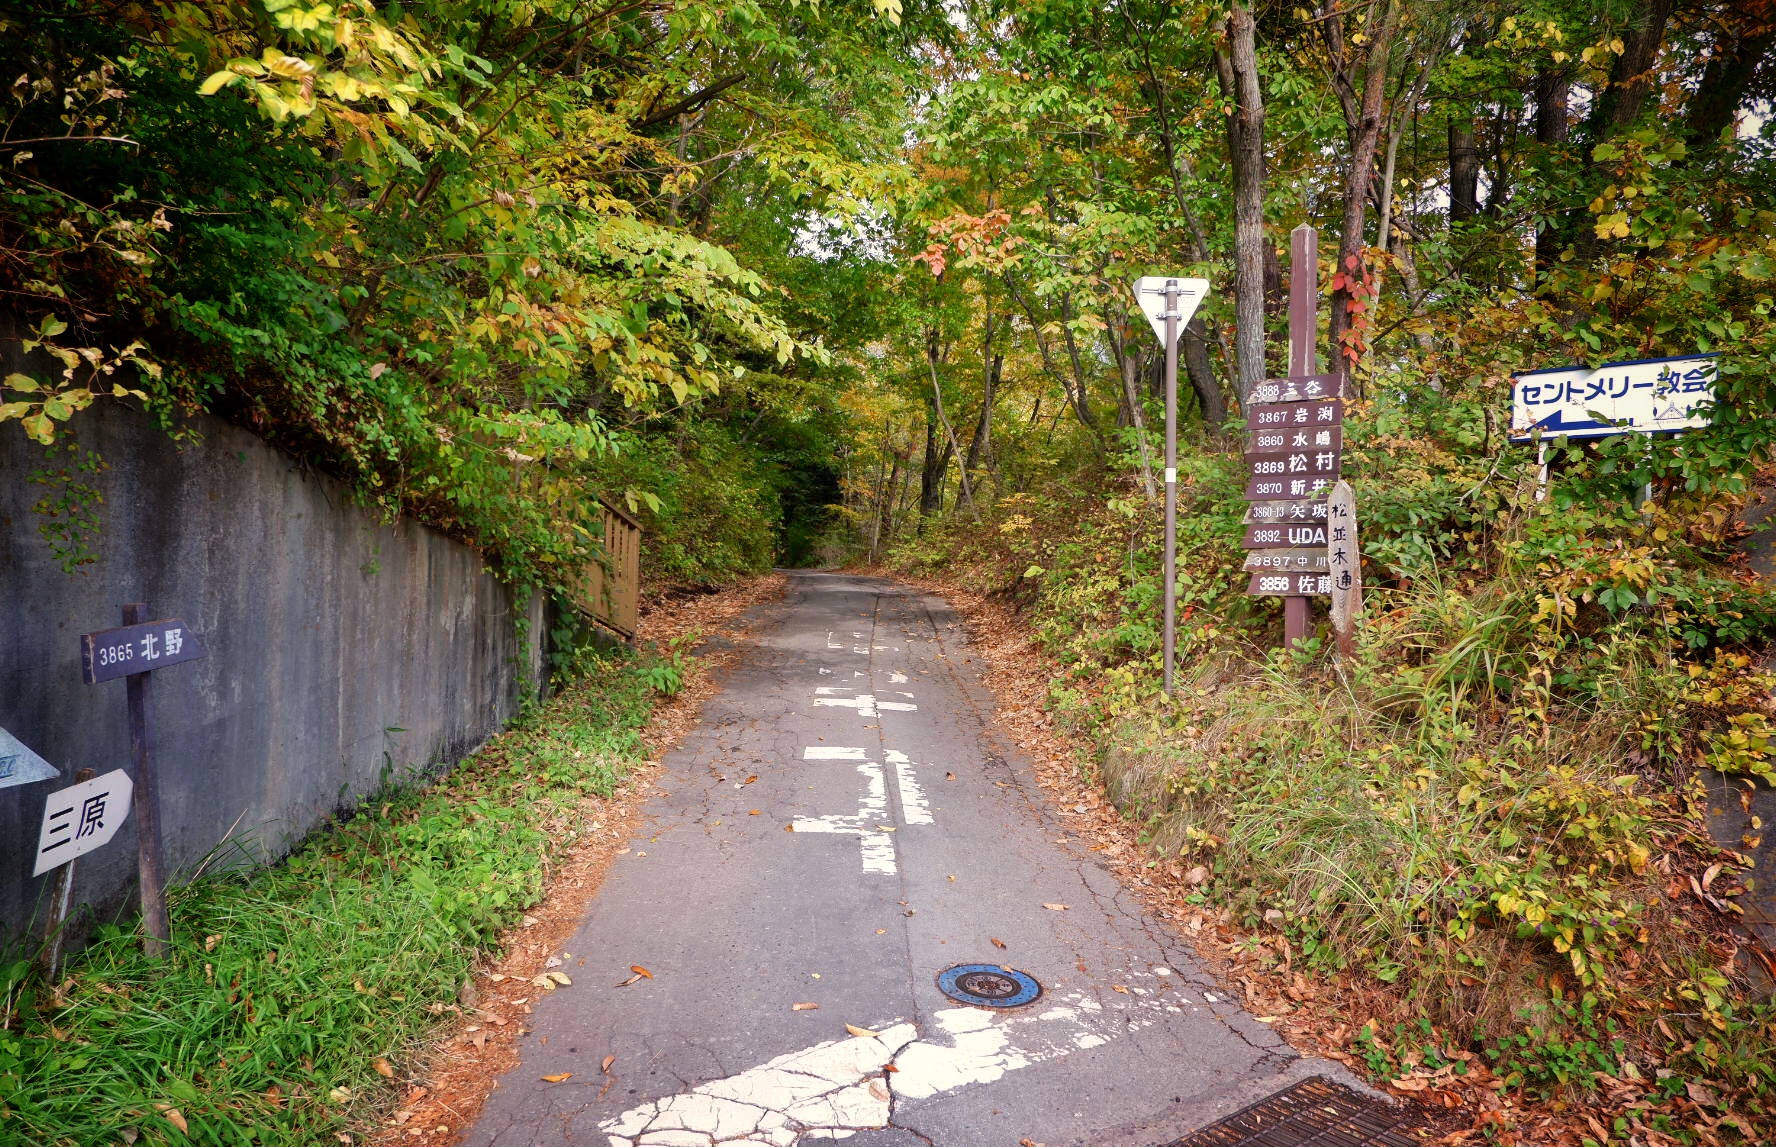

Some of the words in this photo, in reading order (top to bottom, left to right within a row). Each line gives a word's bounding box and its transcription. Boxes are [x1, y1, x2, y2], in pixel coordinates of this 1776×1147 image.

[1256, 385, 1279, 397] 3888
[1281, 380, 1322, 396] 三谷
[1521, 368, 1707, 405] セントメリー教会
[1258, 411, 1287, 423] 3867
[1257, 435, 1283, 446] 3860
[1254, 461, 1284, 474] 3869
[1288, 451, 1335, 472] 松村
[1256, 483, 1282, 494] 3870
[1253, 506, 1284, 517] 3860-13
[1290, 503, 1328, 519] 矢坂
[1254, 530, 1281, 542] 3892
[1288, 527, 1327, 544] UDA
[1254, 556, 1291, 566] 3897
[1297, 555, 1327, 567] 中川
[1297, 575, 1332, 593] 佐藤
[100, 643, 133, 666] 3865
[141, 628, 183, 661] 北野
[41, 791, 110, 854] 三原
